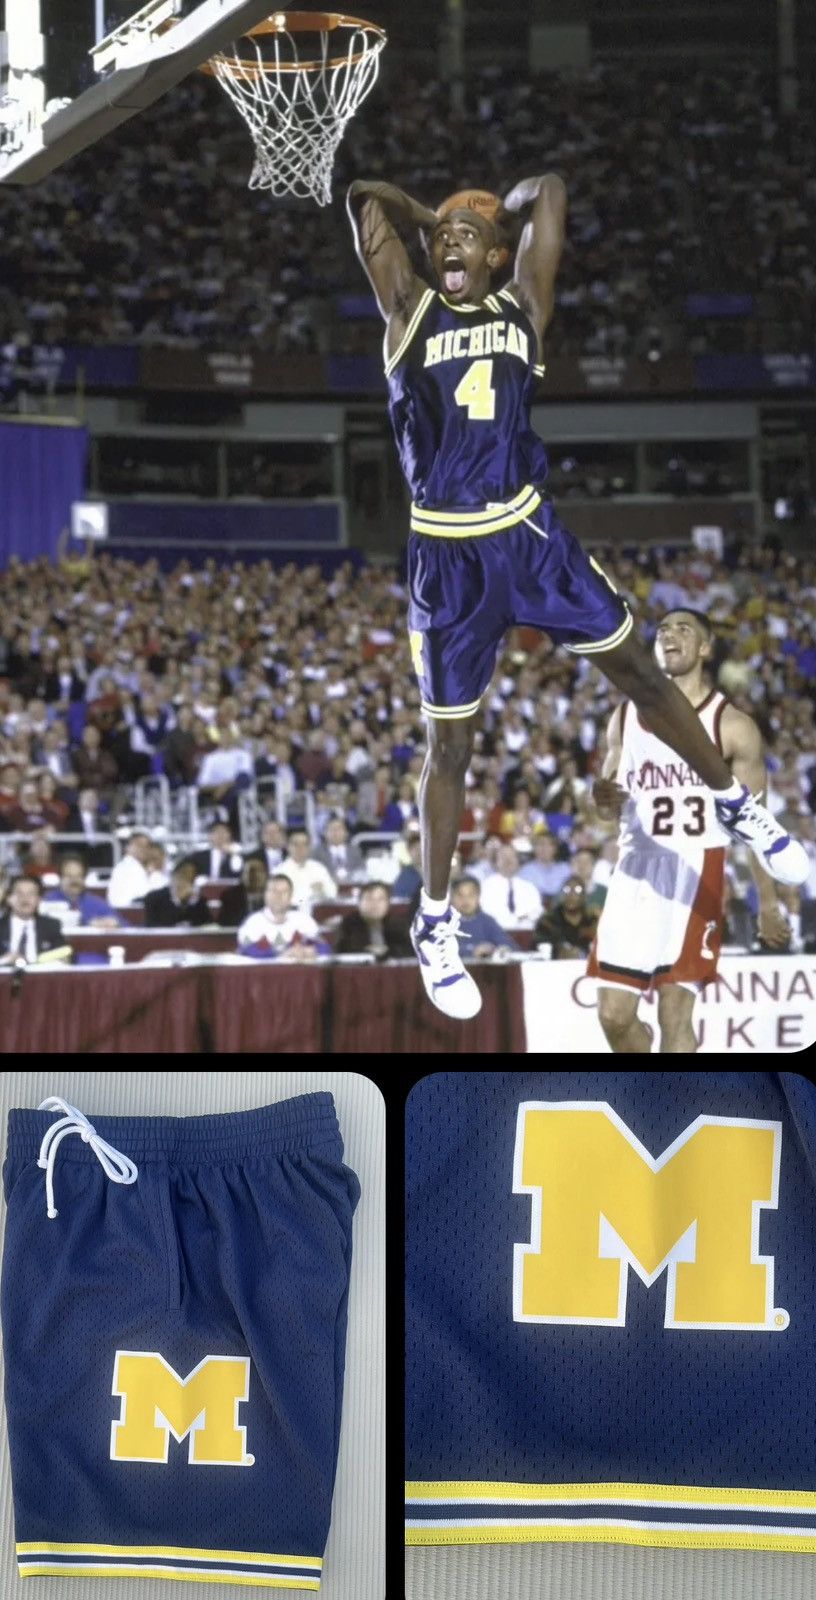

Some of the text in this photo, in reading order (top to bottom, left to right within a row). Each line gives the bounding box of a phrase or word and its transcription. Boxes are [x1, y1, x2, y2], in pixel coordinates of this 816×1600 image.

[423, 320, 529, 367] MICHIGAN
[454, 359, 496, 420] 4
[652, 796, 706, 836] 23
[514, 1101, 784, 1331] M
[110, 1350, 252, 1466] M
